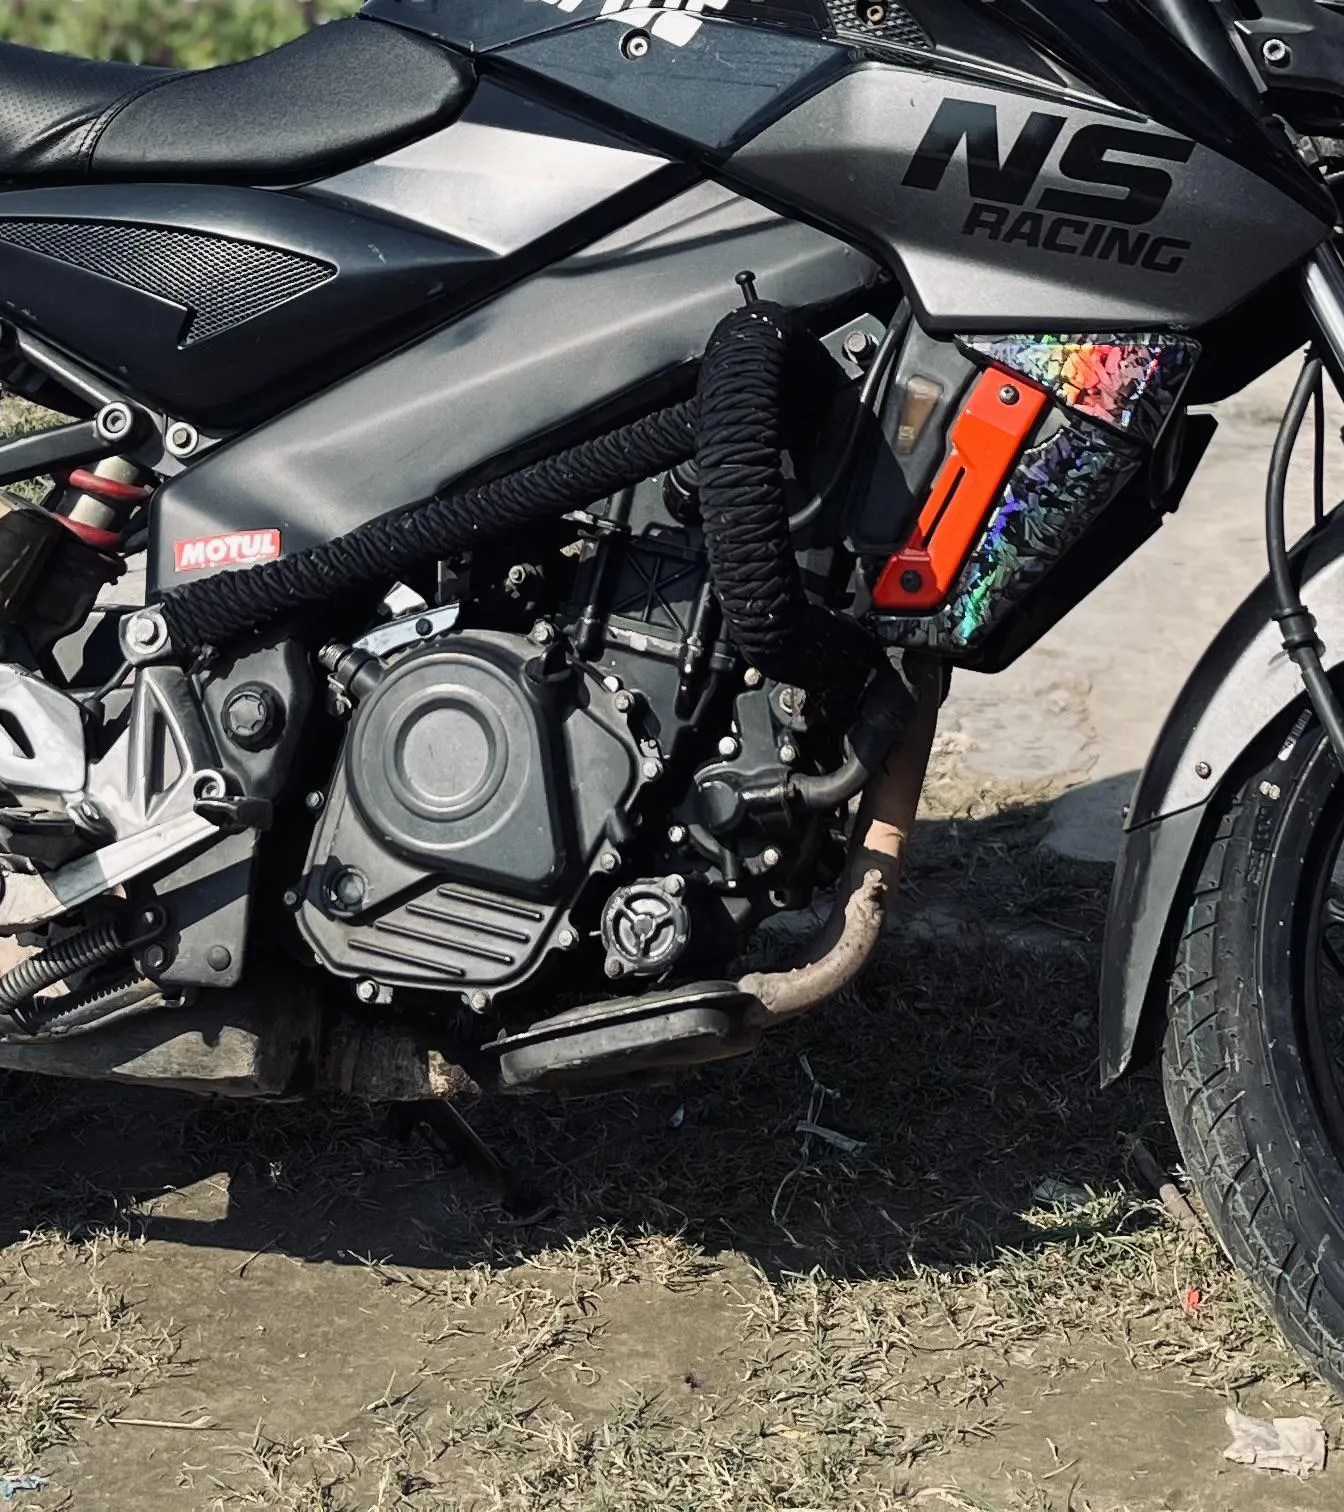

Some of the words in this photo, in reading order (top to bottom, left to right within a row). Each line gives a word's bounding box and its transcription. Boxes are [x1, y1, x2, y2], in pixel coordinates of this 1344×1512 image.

[901, 98, 1197, 226] NS
[961, 202, 1192, 274] RACING
[181, 533, 276, 567] MOTUL
